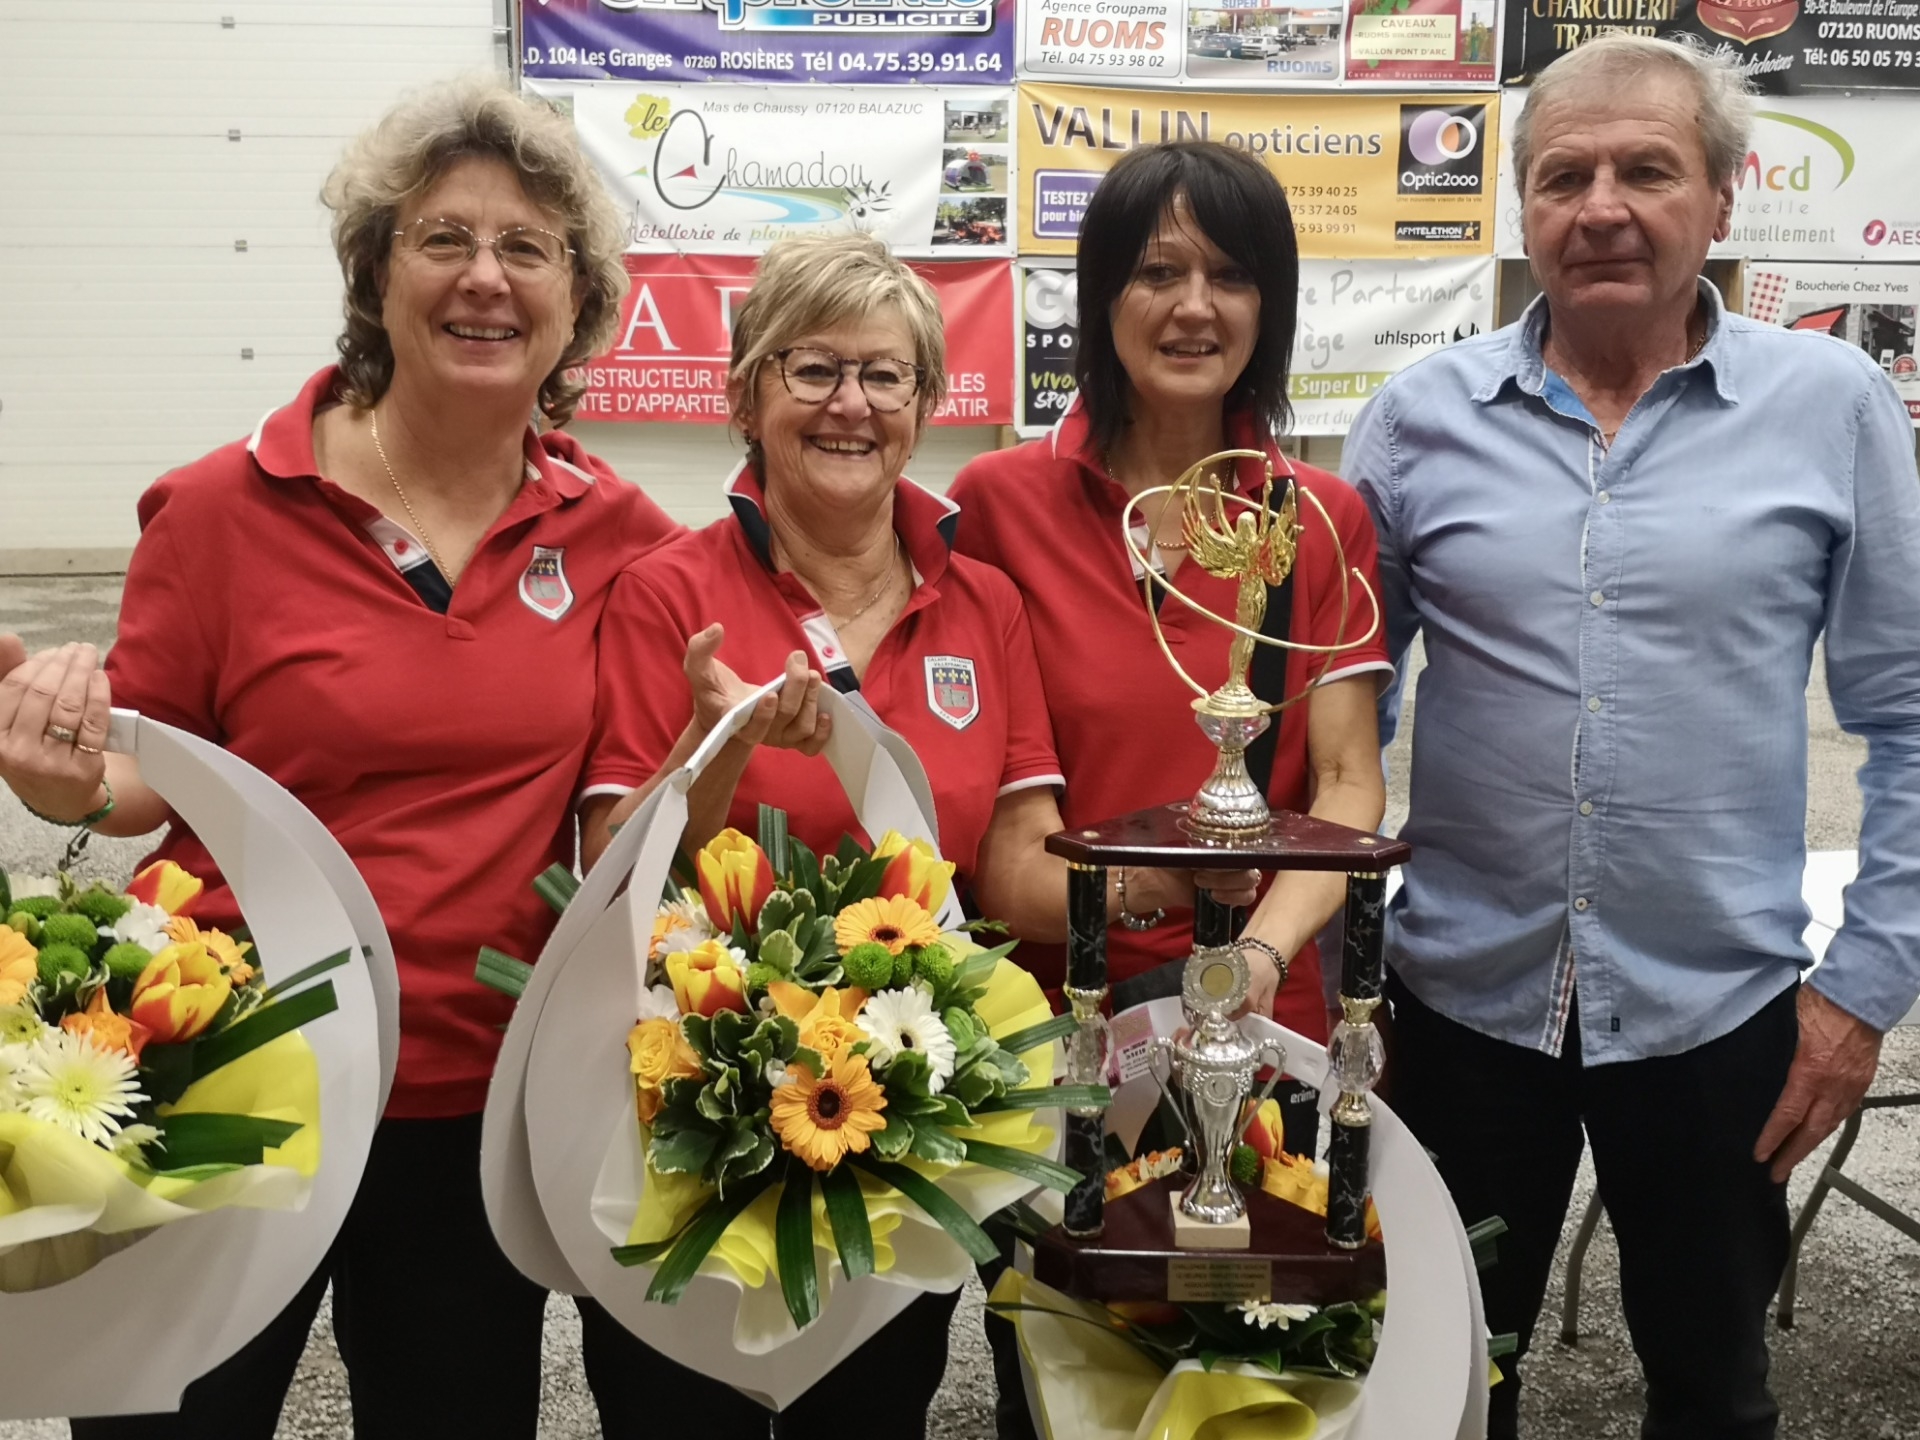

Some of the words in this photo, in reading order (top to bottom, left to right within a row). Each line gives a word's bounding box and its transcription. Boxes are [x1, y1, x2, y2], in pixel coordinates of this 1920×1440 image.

[1041, 0, 1091, 13] Agence
[1096, 2, 1167, 17] Groupama
[1829, 0, 1871, 16] Boulevard
[1872, 0, 1884, 16] de
[812, 11, 979, 26] PUBLICITÉ
[1381, 19, 1436, 28] CAVEAUX
[1040, 17, 1166, 50] RUOMS
[1818, 22, 1863, 39] 07120
[1866, 23, 1920, 40] RUOMS
[548, 48, 577, 65] 104
[580, 48, 606, 67] Les
[609, 49, 672, 70] Granges
[684, 55, 717, 69] 07260
[720, 48, 794, 70] ROSIÈRES
[802, 52, 833, 71] Tél
[838, 52, 1002, 72] 04.75.39.91.64
[1041, 52, 1064, 64] Tél.
[1069, 53, 1084, 64] 04
[1089, 54, 1105, 65] 75
[1109, 55, 1125, 66] 93
[1128, 55, 1145, 67] 98
[1149, 56, 1165, 67] 02
[1803, 48, 1828, 65] Tél:
[1830, 49, 1849, 66] 06
[1851, 50, 1870, 66] 50
[1873, 50, 1891, 67] 05
[1894, 51, 1912, 67] 79
[1267, 60, 1333, 73] RUOMS
[703, 102, 729, 113] Mas
[733, 102, 749, 112] de
[754, 102, 808, 116] Chaussy
[816, 103, 855, 114] 07120
[858, 103, 923, 115] BALAZUC
[643, 103, 666, 132] le
[1225, 124, 1381, 157] opticiens
[653, 109, 866, 210] Chamadou
[1042, 190, 1088, 206] TESTEZ
[1292, 186, 1305, 196] 75
[1309, 186, 1323, 196] 39
[1326, 186, 1340, 197] 40
[1343, 186, 1357, 197] 25
[1292, 205, 1305, 215] 75
[1309, 205, 1322, 215] 37
[1326, 205, 1340, 215] 24
[1343, 205, 1357, 215] 05
[1737, 201, 1809, 214] tuelle
[1042, 212, 1067, 224] pour
[723, 231, 741, 240] de
[1309, 223, 1323, 233] 93
[1326, 223, 1340, 233] 99
[1343, 223, 1356, 233] 91
[1729, 225, 1836, 243] utuellement
[1330, 269, 1483, 306] Partenaire
[1796, 280, 1850, 292] Boucherie
[1853, 281, 1881, 292] Chez
[1884, 282, 1909, 293] Yves
[1374, 330, 1446, 348] uhlsport
[563, 368, 712, 389] ONSTRUCTEUR
[1299, 375, 1350, 399] Super
[1355, 374, 1367, 393] U
[617, 394, 730, 414] D'APPARTE
[1333, 410, 1352, 424] du
